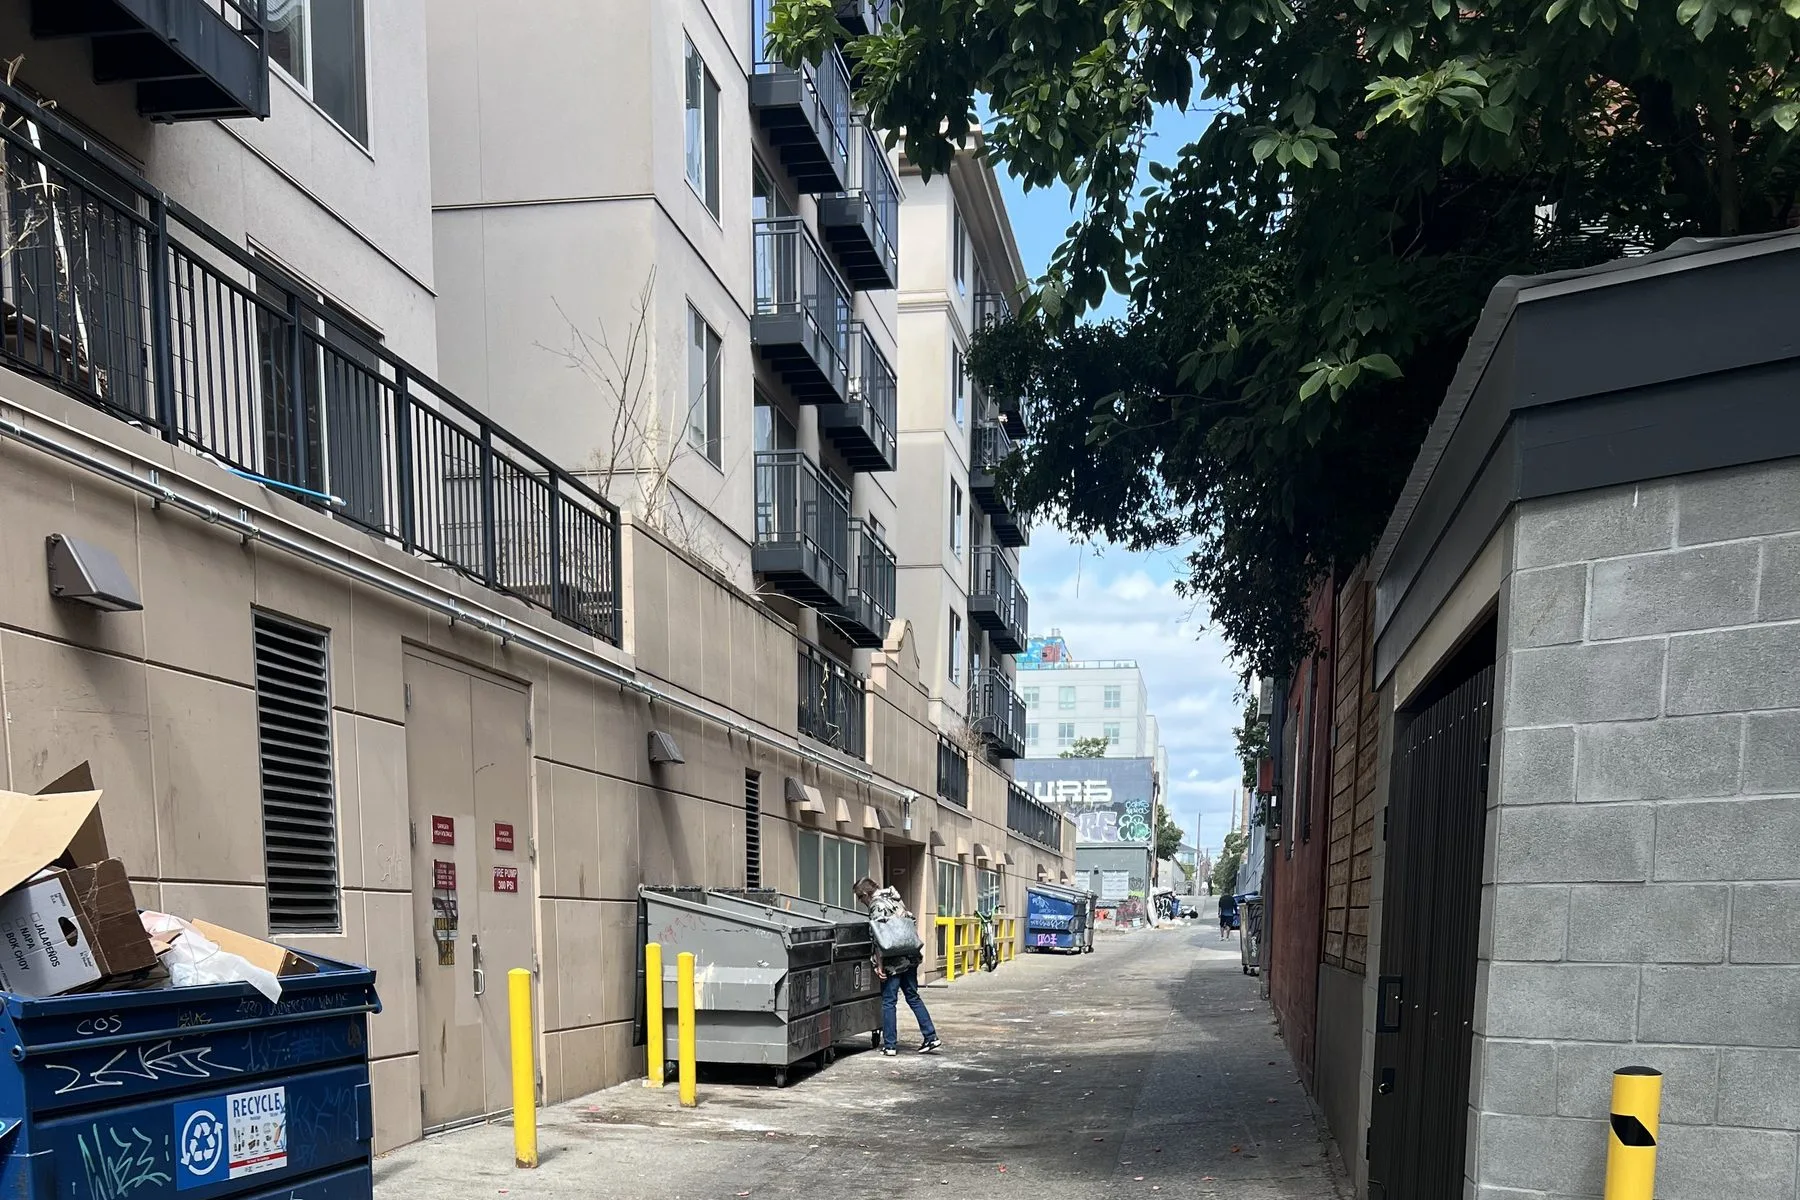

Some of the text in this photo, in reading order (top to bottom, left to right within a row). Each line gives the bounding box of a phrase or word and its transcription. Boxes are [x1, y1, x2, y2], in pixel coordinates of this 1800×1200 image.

[494, 868, 504, 878] FIRE
[6, 932, 20, 950] BOK
[14, 950, 30, 971] CHOY
[20, 927, 36, 950] NAPA
[35, 923, 60, 967] JALAPEÑOS
[233, 1092, 281, 1118] RECYCLE
